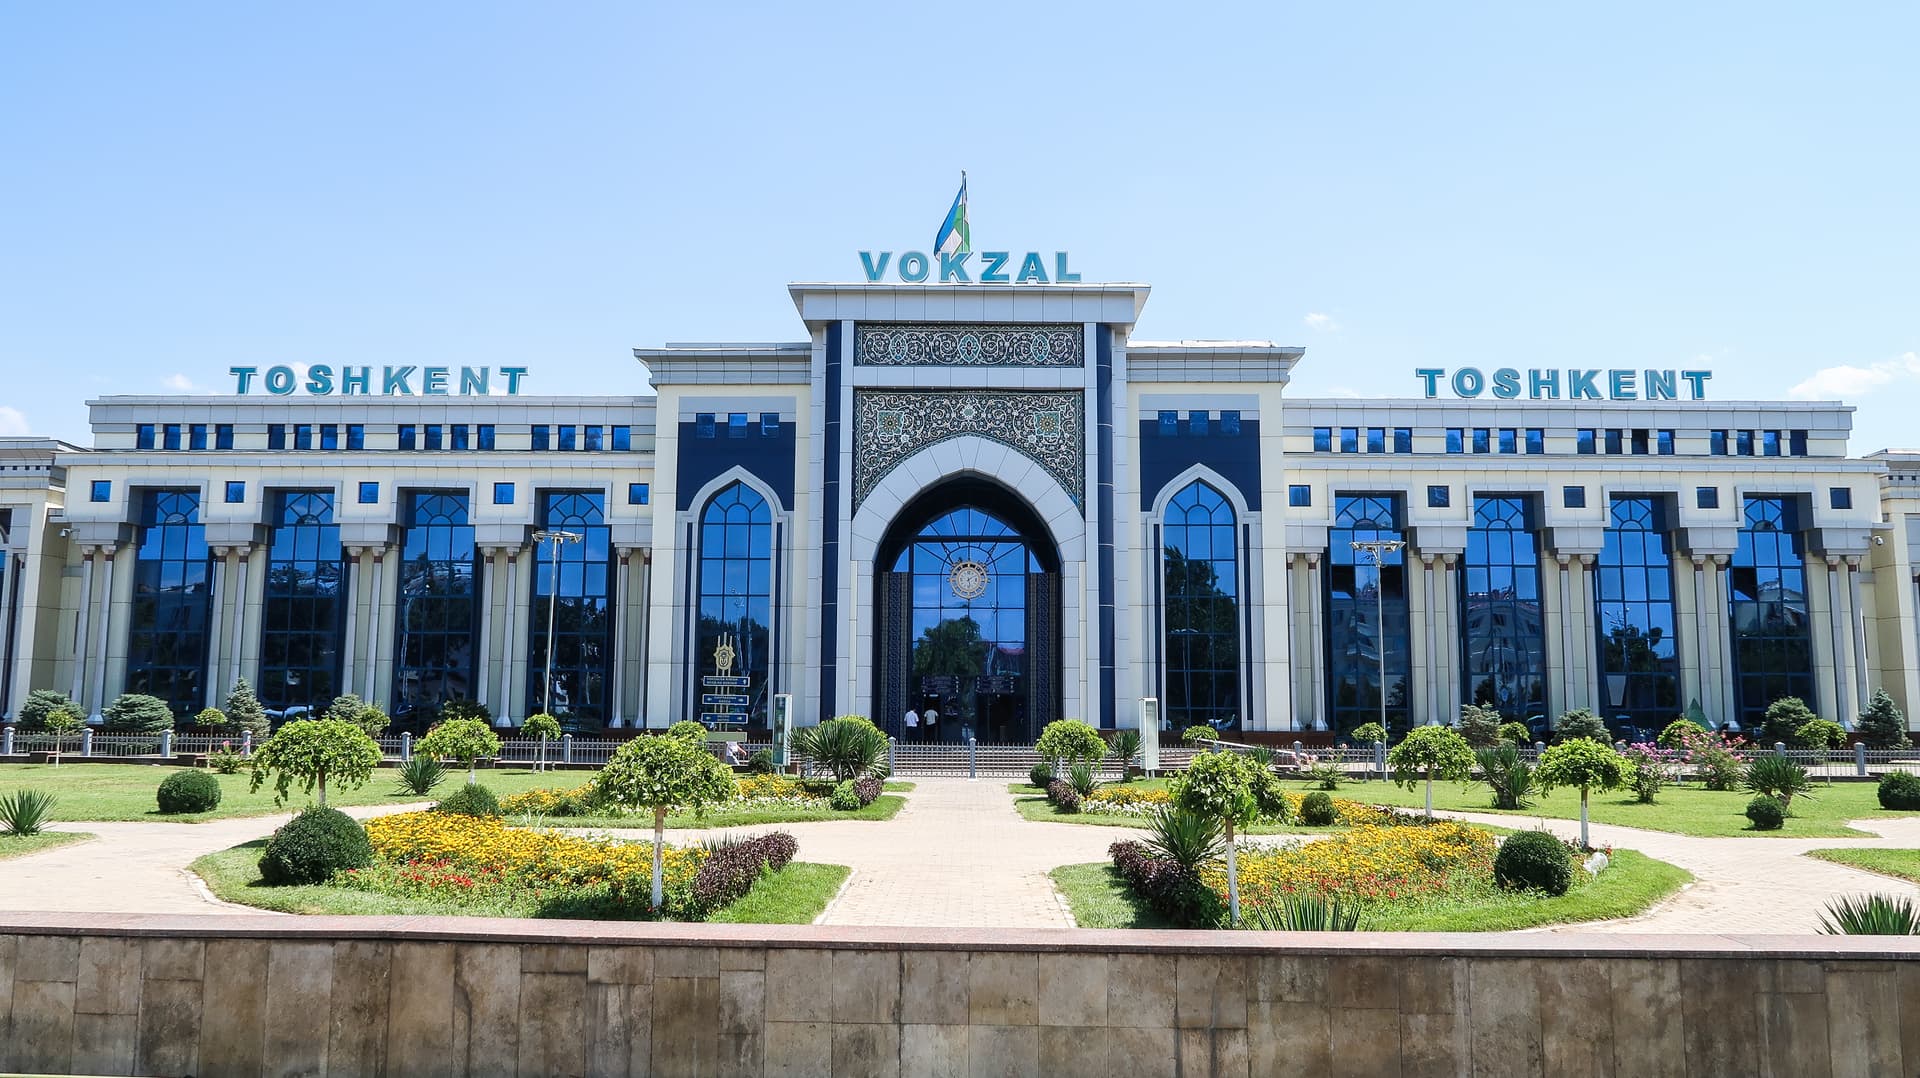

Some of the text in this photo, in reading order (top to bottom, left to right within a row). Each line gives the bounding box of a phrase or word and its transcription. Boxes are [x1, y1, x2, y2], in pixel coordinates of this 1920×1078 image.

[859, 251, 1082, 284] VOKZAL
[229, 364, 528, 396] TOSHKENT
[1416, 367, 1712, 400] TOSHKENT
